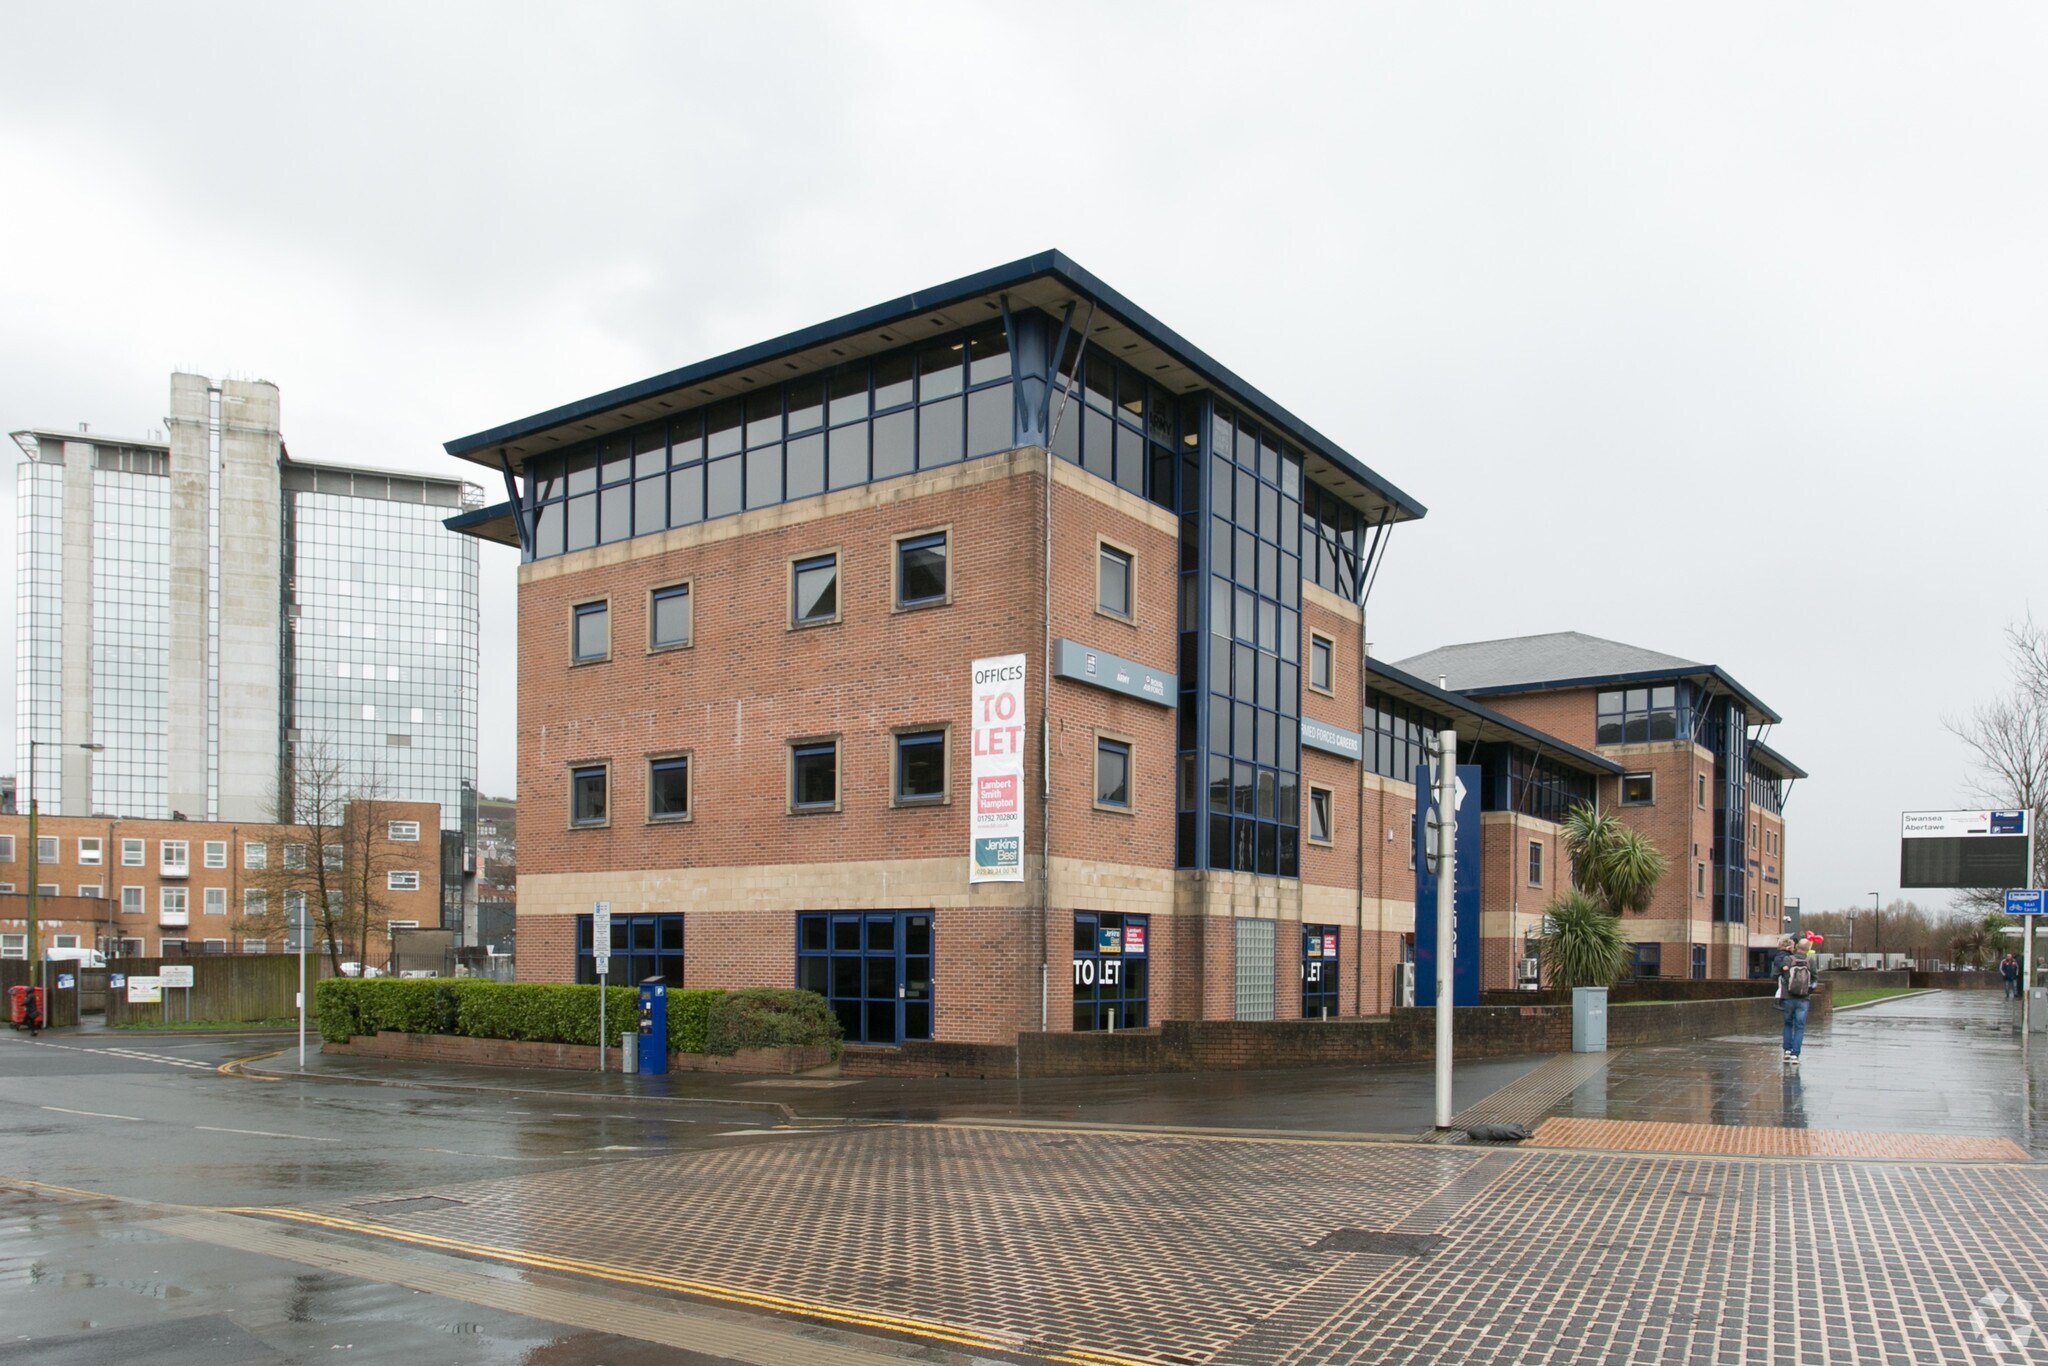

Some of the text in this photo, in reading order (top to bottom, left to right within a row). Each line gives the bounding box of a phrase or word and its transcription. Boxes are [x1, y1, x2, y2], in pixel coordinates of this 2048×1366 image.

[975, 665, 1023, 685] OFFICES
[979, 692, 1016, 722] TO
[974, 726, 1022, 756] LET
[1316, 728, 1336, 745] FORCES
[1336, 735, 1358, 751] CAREERS
[981, 779, 1012, 790] Lambert
[981, 789, 1002, 799] Smith
[981, 799, 1014, 809] Hampton
[985, 839, 1018, 850] Jenkins
[997, 850, 1018, 860] Best
[1073, 960, 1121, 985] TO LET
